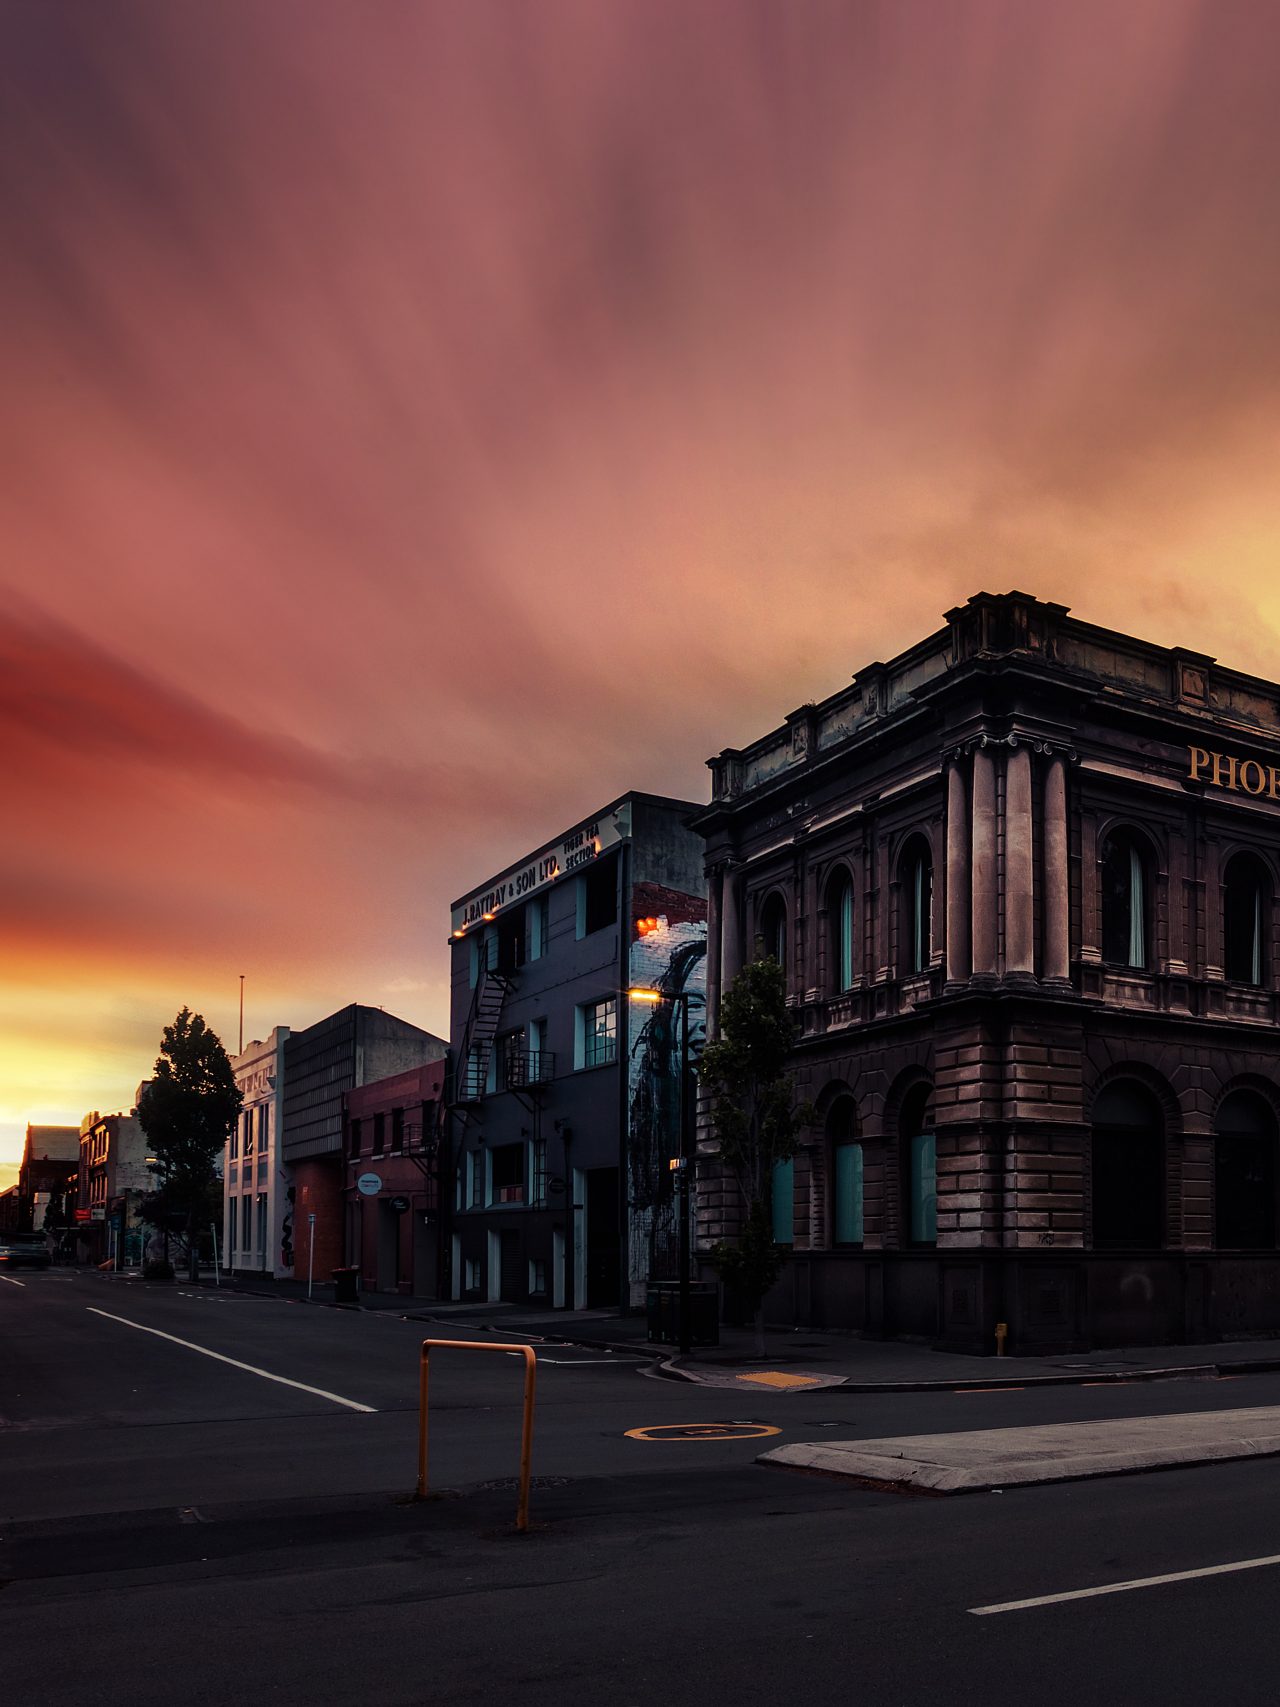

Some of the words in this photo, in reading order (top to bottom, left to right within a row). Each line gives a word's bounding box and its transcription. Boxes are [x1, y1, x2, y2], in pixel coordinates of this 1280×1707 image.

[564, 833, 584, 854] TIGER
[586, 823, 600, 840] TEA
[566, 842, 597, 869] SECTION
[516, 866, 536, 895] SON
[539, 855, 560, 881] LTD.
